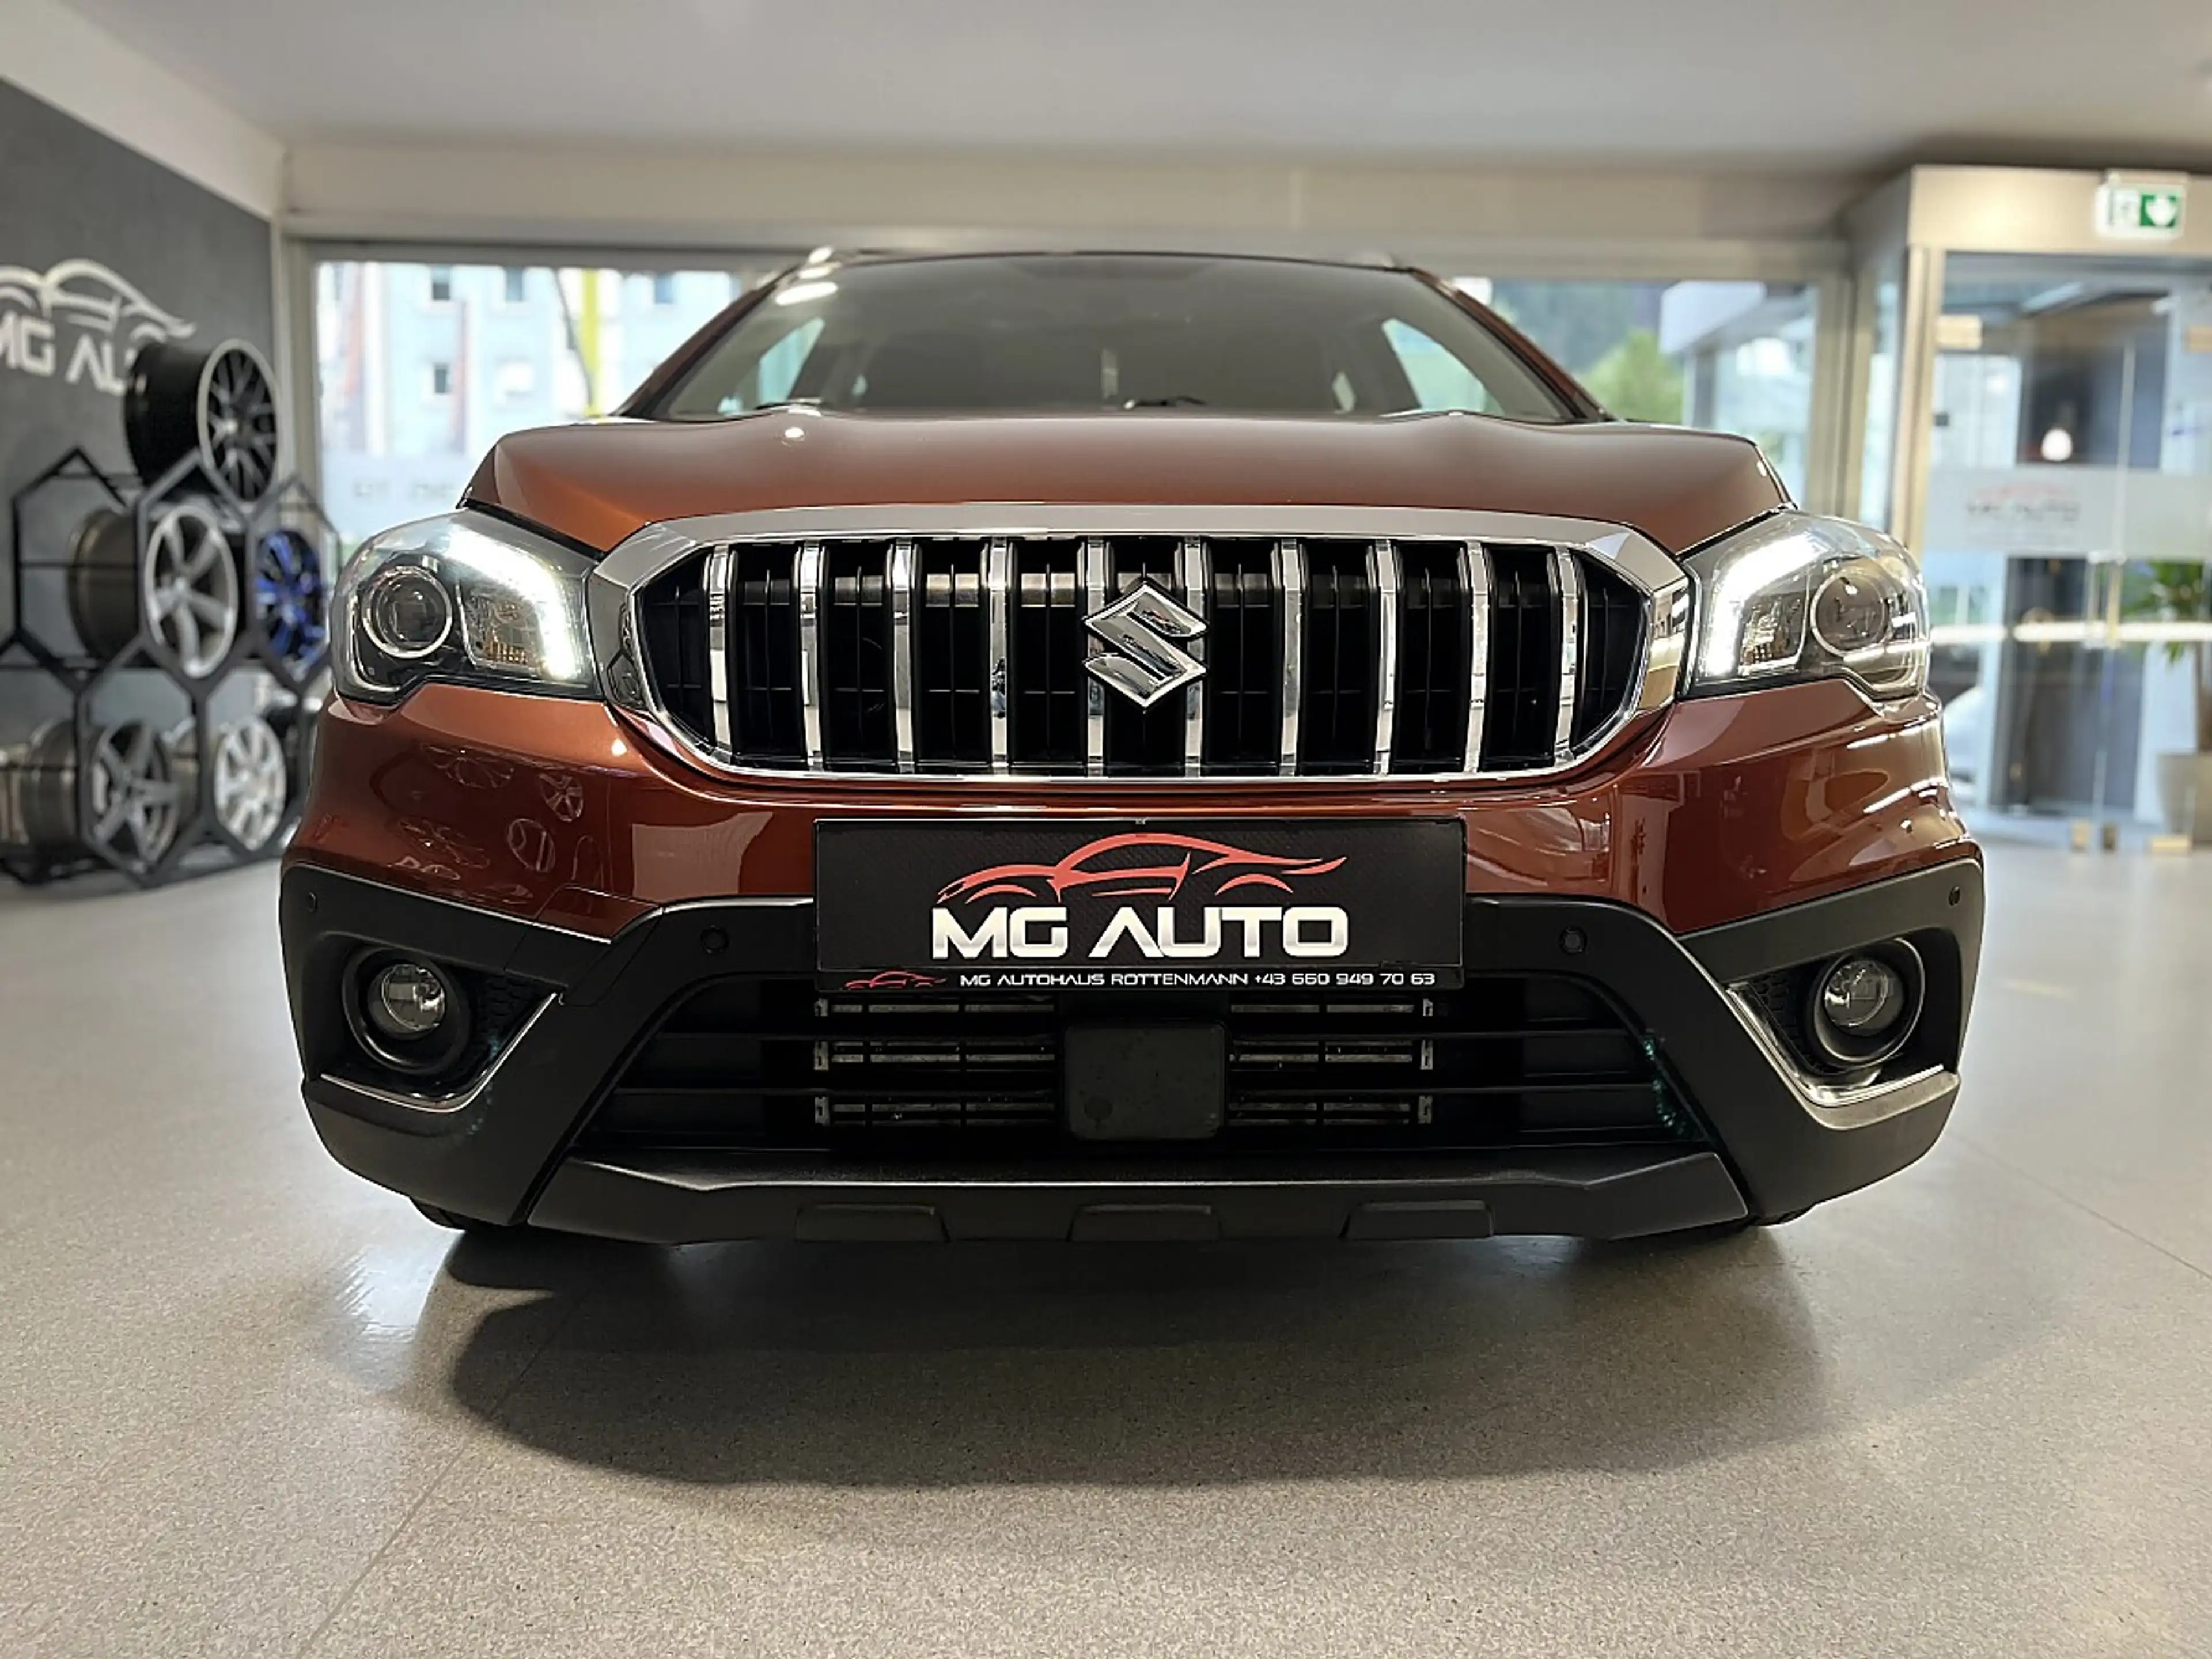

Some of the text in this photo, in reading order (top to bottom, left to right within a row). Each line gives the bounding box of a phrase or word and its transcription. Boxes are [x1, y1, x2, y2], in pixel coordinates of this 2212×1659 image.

[931, 906, 1349, 959] MG AUTO
[959, 972, 1435, 987] MG AUTOHAUS ROTTENMANN +43 660 949 70 63
